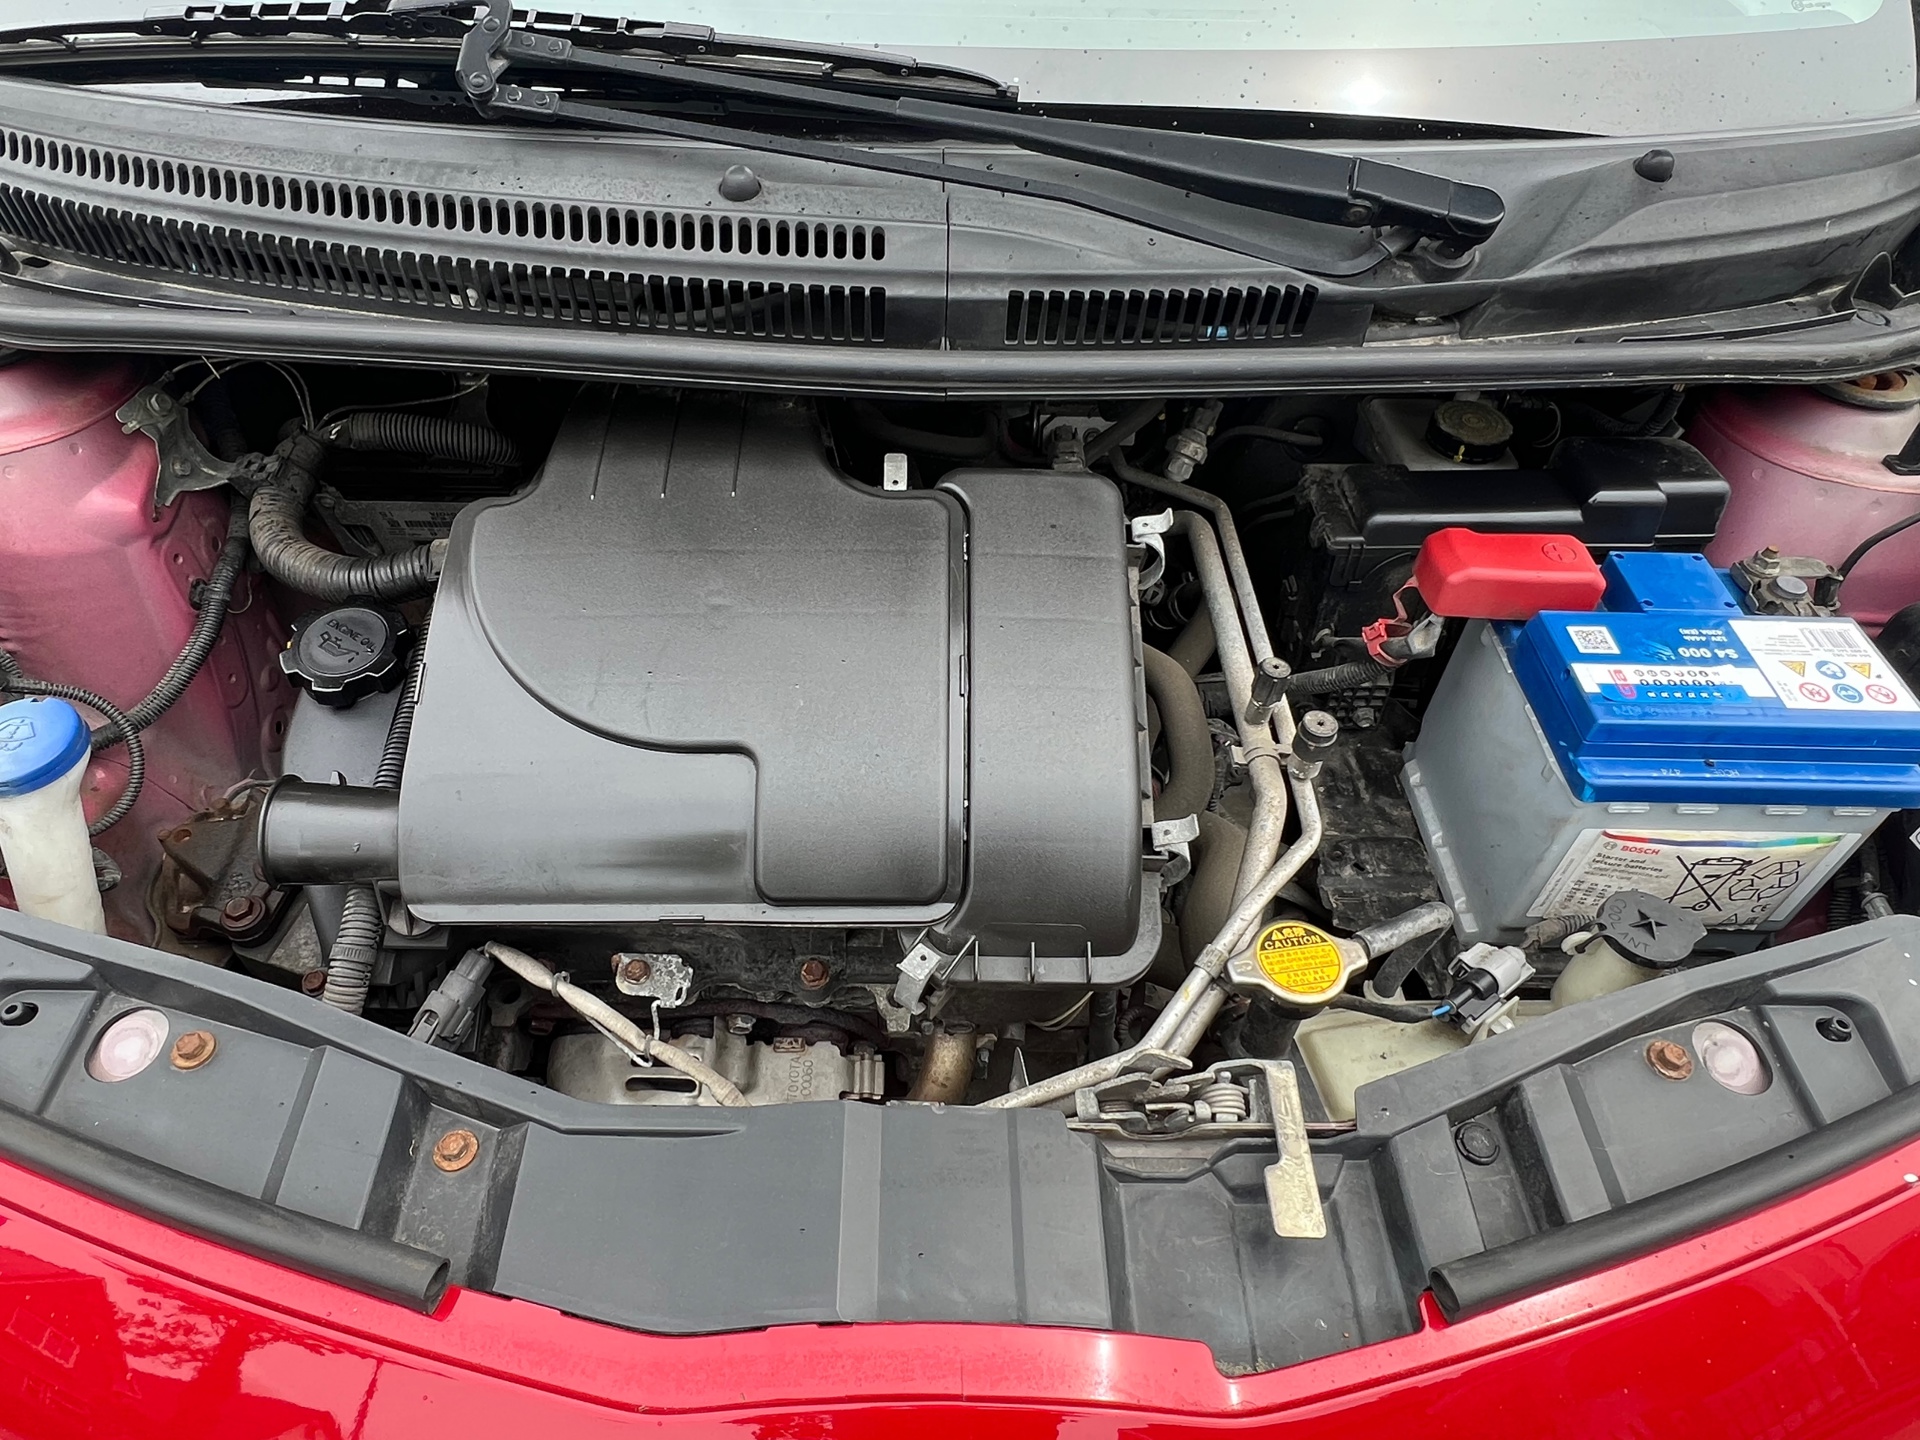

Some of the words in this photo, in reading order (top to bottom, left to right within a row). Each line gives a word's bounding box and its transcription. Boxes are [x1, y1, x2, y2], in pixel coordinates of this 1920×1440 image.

[326, 618, 362, 642] ENGINE
[360, 635, 377, 655] OIL
[1678, 647, 1713, 658] 000
[1714, 648, 1739, 659] S4
[1620, 845, 1661, 855] BOSCH
[1595, 852, 1628, 862] Starter
[1592, 858, 1622, 867] leisure
[1624, 863, 1663, 873] batteries
[1608, 898, 1651, 953] COOLANT
[1264, 934, 1322, 950] CAUTION
[1286, 956, 1303, 964] OPEN
[1287, 968, 1326, 979] ENGINE
[1286, 974, 1331, 986] COOLANT
[787, 1056, 801, 1101] TOYOTA
